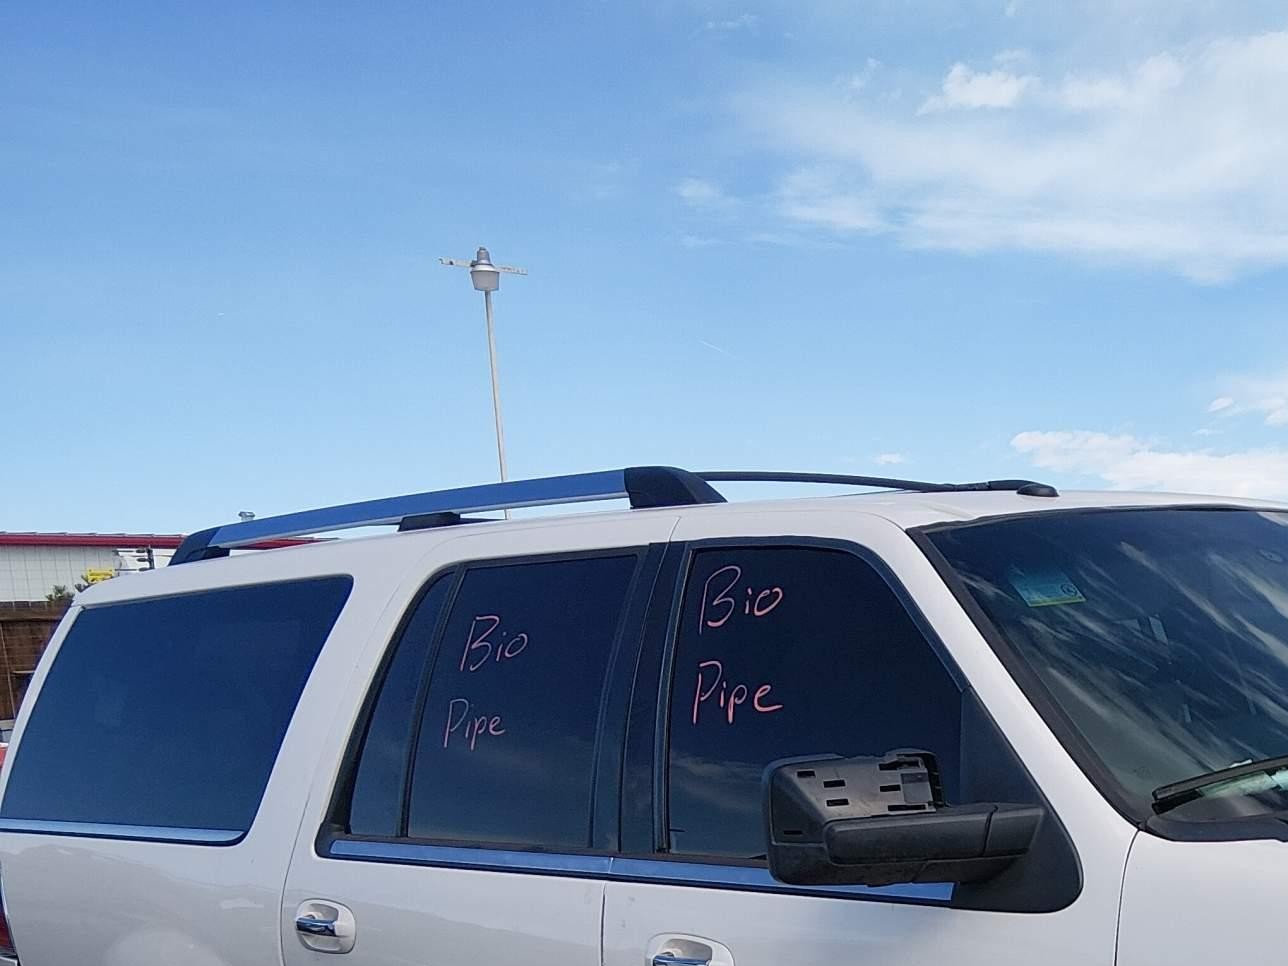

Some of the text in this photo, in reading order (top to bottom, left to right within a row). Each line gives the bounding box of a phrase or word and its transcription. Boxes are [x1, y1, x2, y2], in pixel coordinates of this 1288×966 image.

[699, 565, 783, 634] Bio
[459, 615, 528, 672] Bio
[692, 660, 783, 725] Pipe
[442, 698, 505, 750] Pipe
